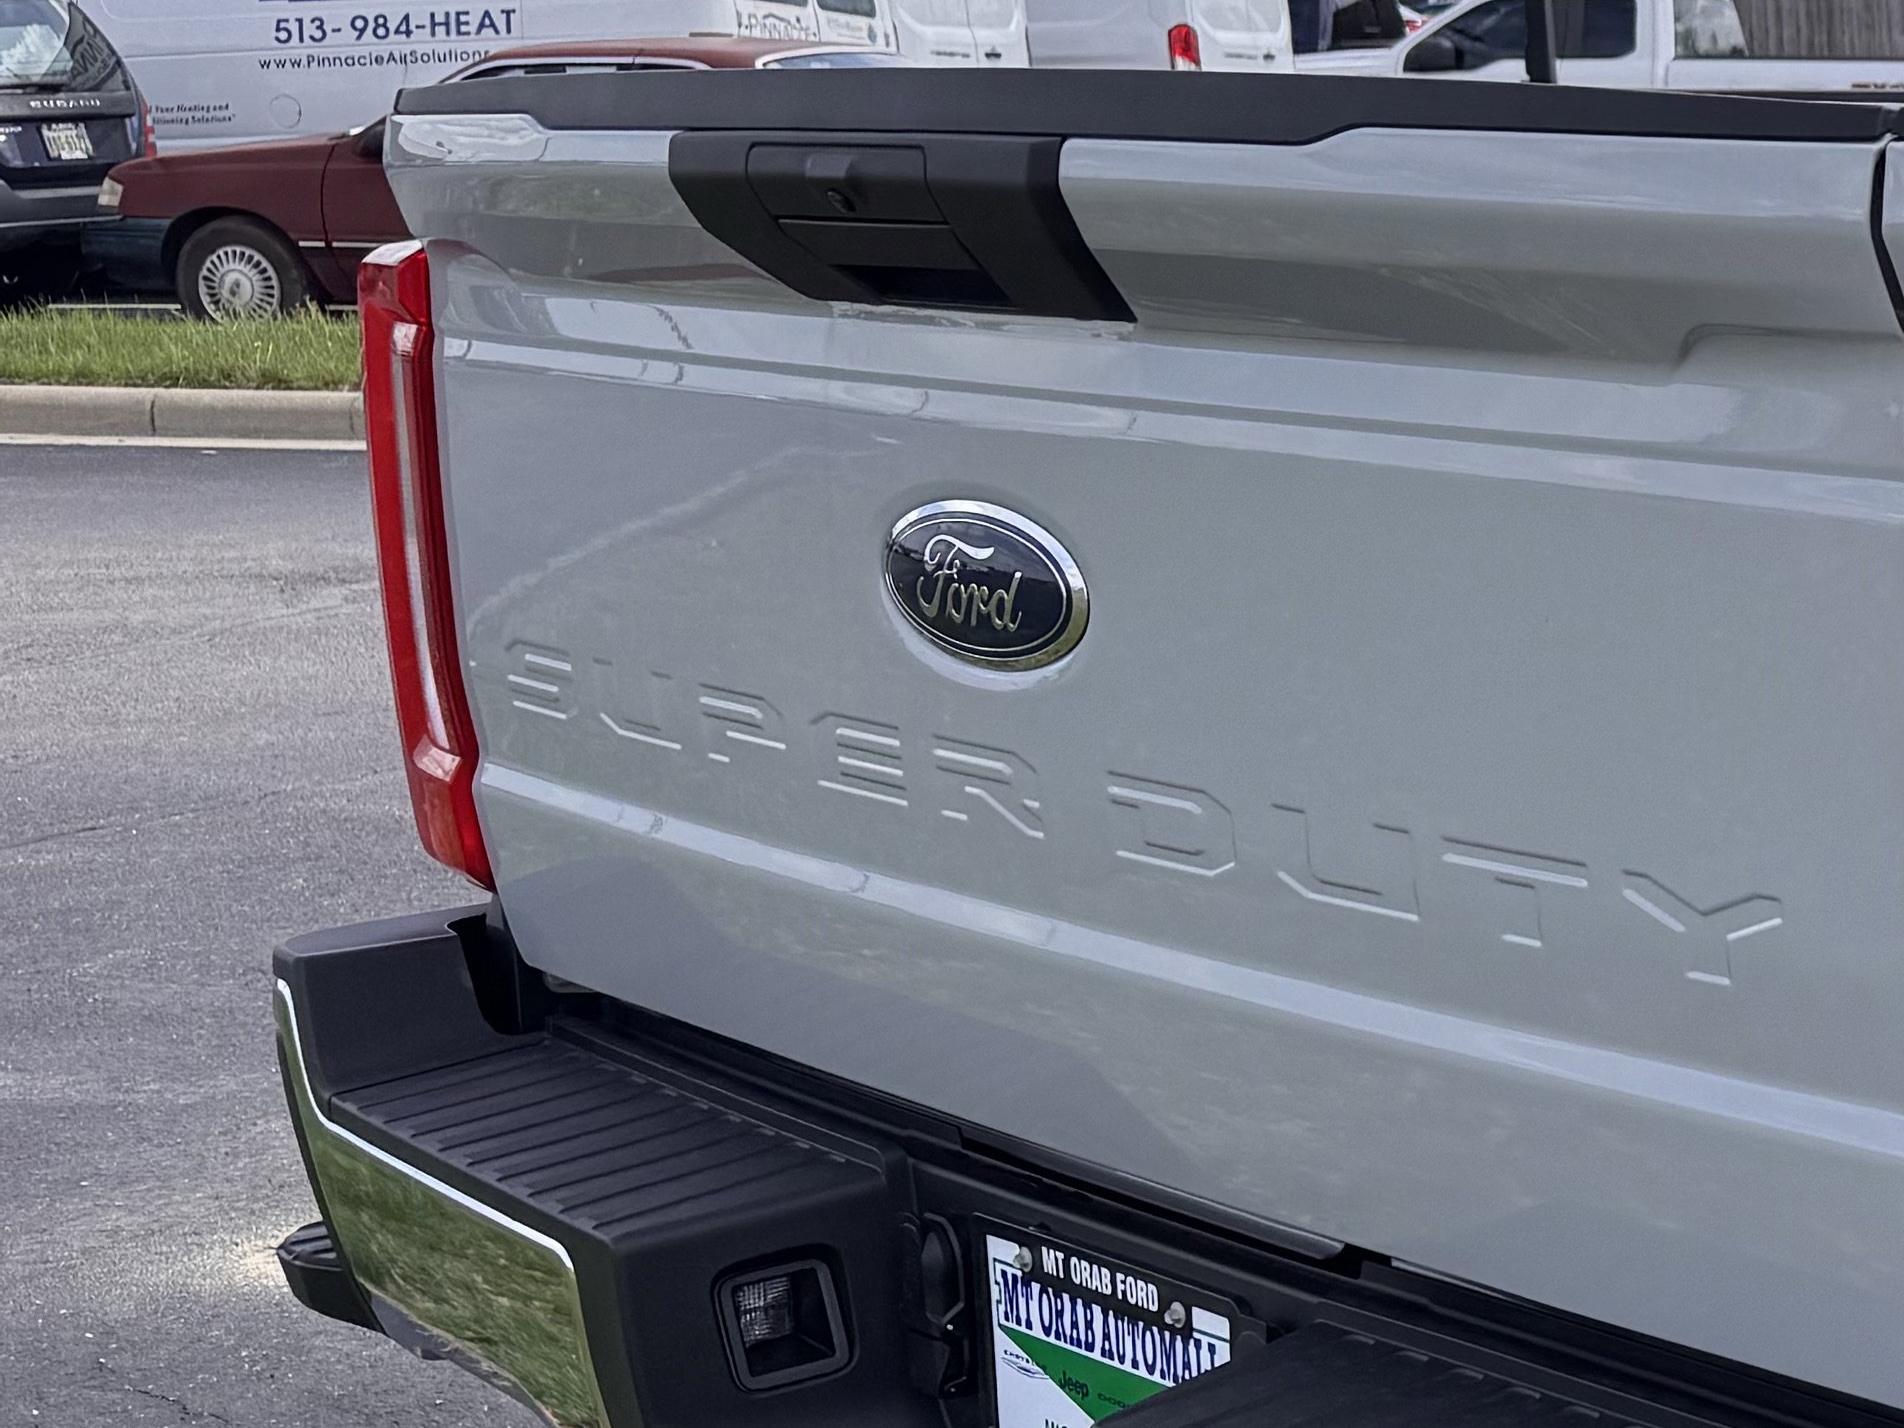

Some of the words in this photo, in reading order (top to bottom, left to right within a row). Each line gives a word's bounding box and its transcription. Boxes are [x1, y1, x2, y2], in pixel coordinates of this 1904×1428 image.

[916, 534, 1023, 632] Ford
[503, 638, 1045, 840] SUPER
[1107, 770, 1784, 986] DUTY
[1000, 1269, 1040, 1332] MT
[1038, 1286, 1097, 1354] ORAB
[1041, 1245, 1065, 1279] MT
[1070, 1256, 1111, 1296] ORAB
[1116, 1272, 1159, 1312] FORD
[1060, 1370, 1089, 1401] Jeep
